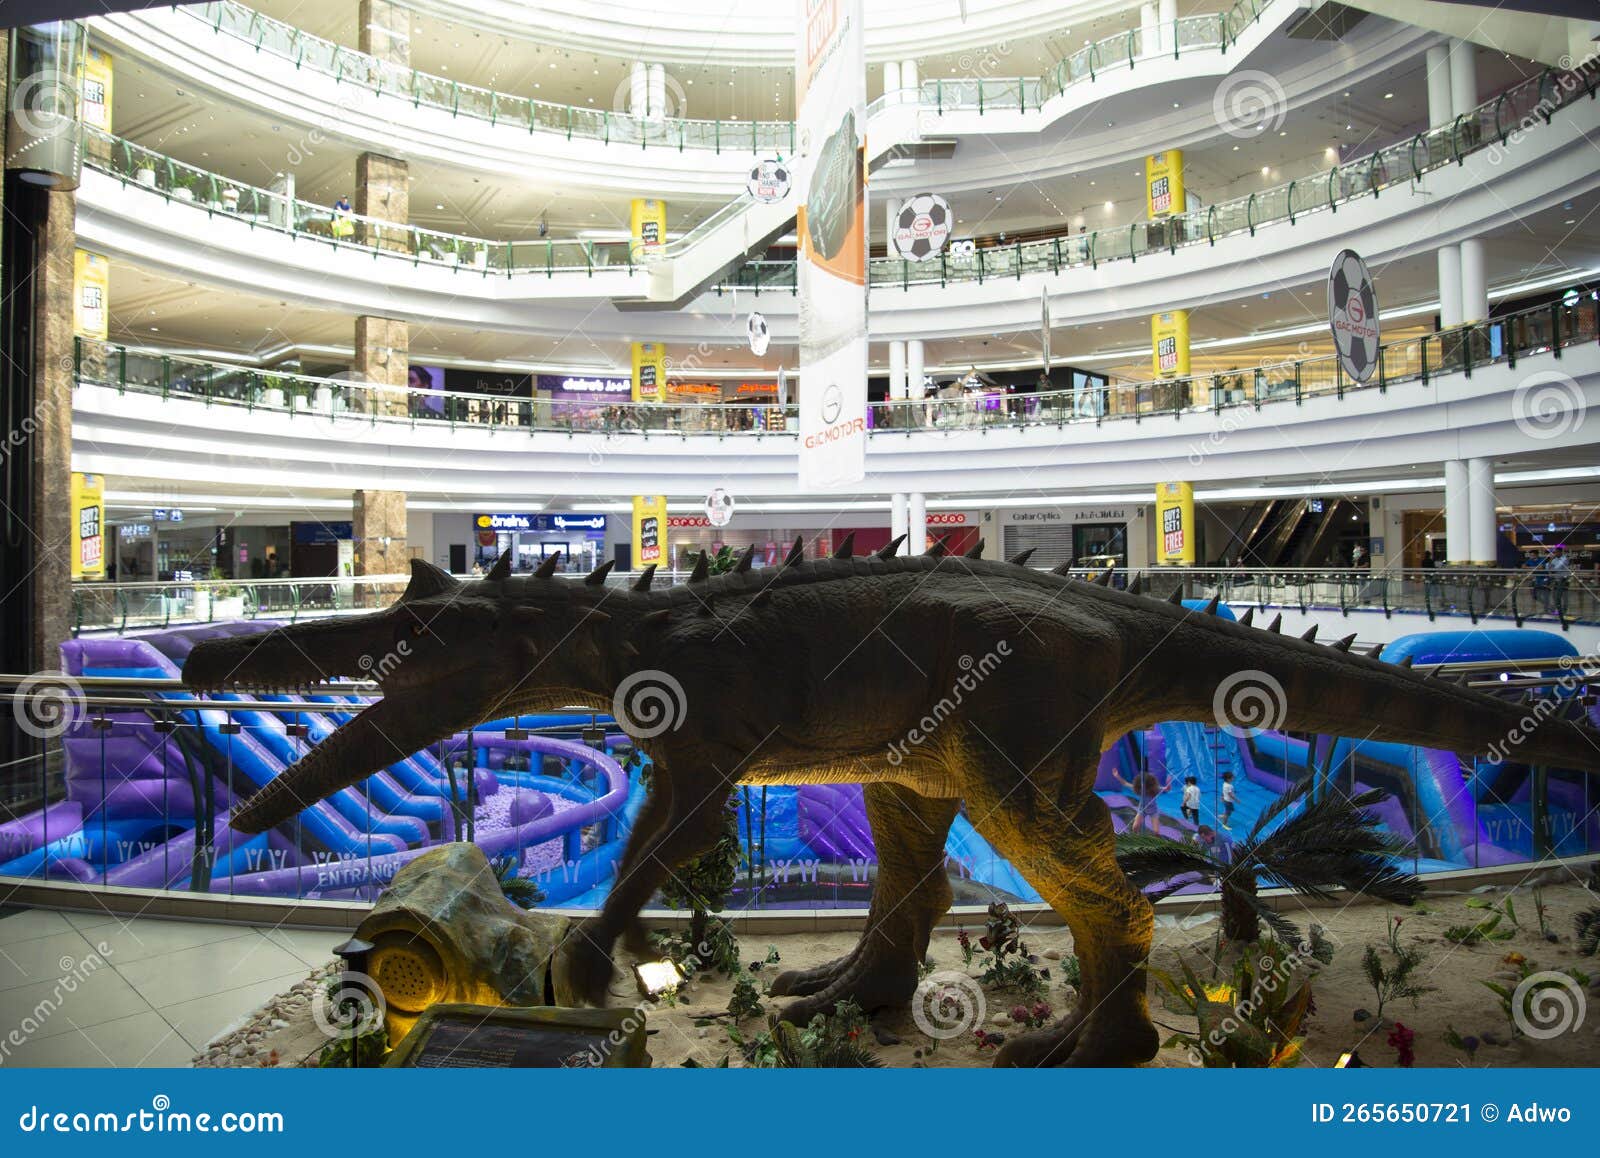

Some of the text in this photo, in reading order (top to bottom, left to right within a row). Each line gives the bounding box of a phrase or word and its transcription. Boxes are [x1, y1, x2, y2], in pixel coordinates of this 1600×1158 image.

[825, 417, 864, 442] MOTOR
[667, 517, 711, 526] ooredo
[926, 513, 966, 523] redoo
[1036, 511, 1061, 522] Optics
[82, 537, 100, 561] FREE
[1165, 530, 1183, 552] FREE
